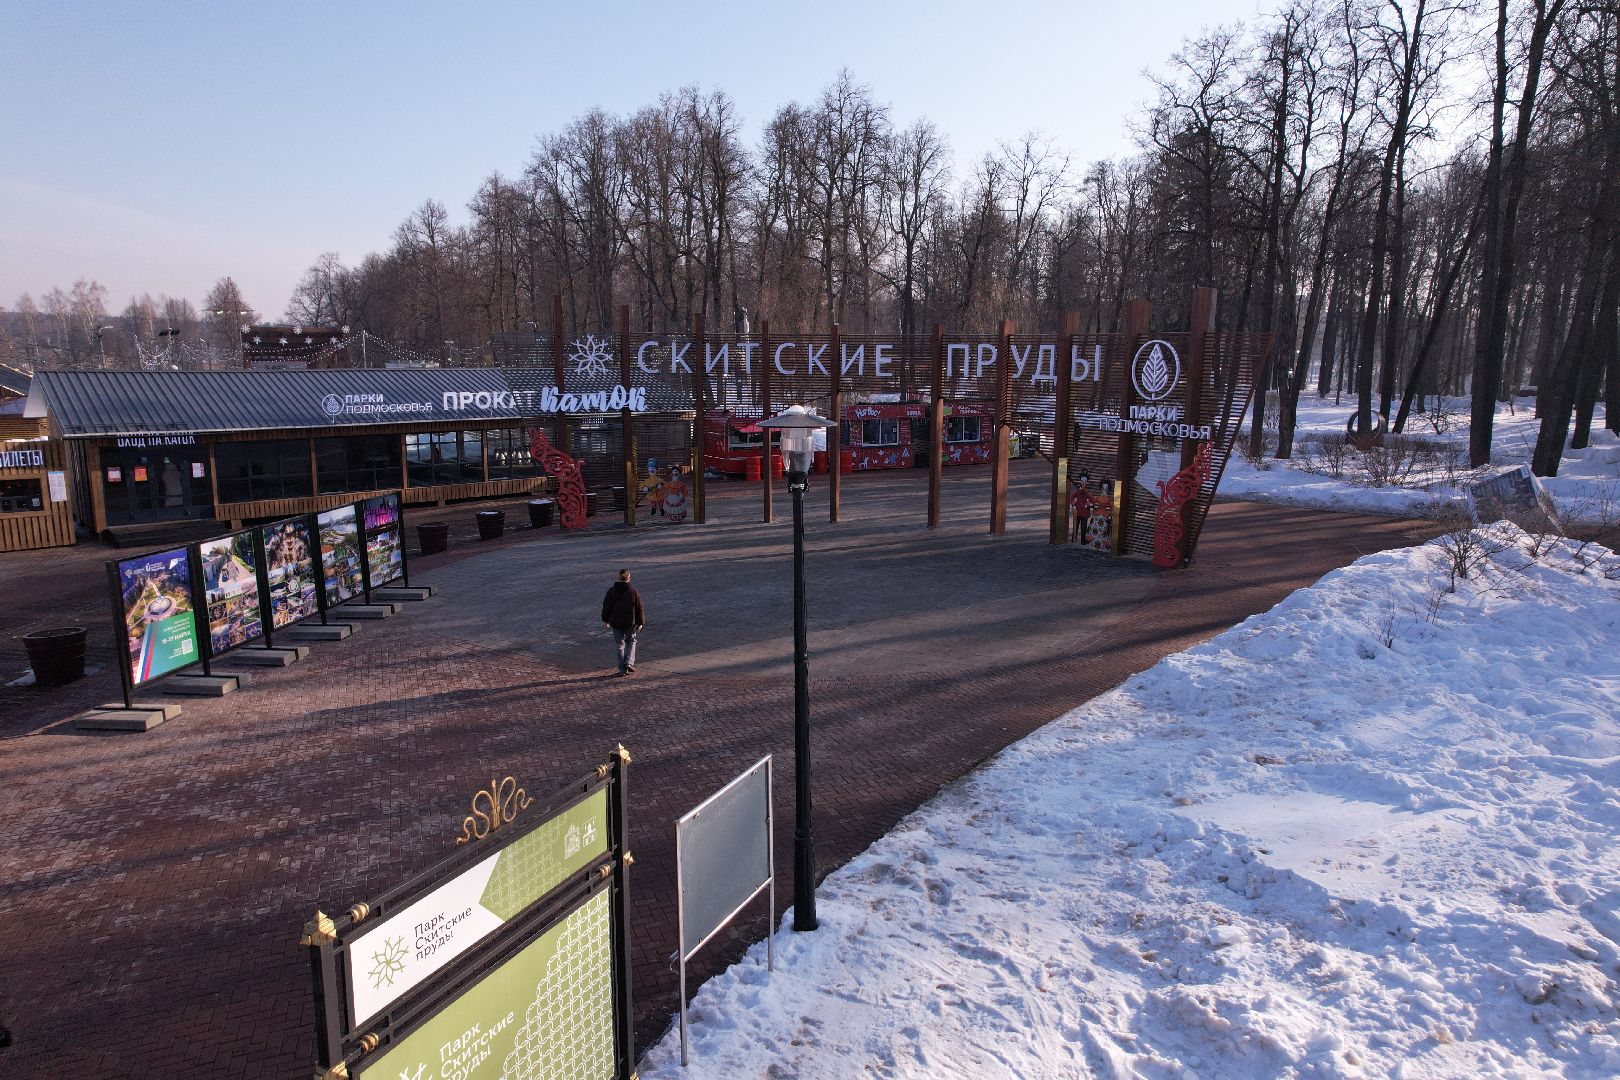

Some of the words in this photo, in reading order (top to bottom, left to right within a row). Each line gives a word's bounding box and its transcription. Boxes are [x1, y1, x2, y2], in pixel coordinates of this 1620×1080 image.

[637, 340, 893, 377] СКИТСКИЕ
[947, 343, 1102, 386] ПРУДЫ
[345, 394, 384, 403] ПАРКИ
[346, 402, 433, 414] ПОДМОСКОВЬЯ
[1129, 405, 1178, 421] ПАРКИ
[1099, 417, 1211, 440] ПОДМОСКОВЬЯ
[414, 911, 445, 938] Парк
[415, 907, 472, 950] Скитские
[416, 930, 454, 961] пруды
[439, 1022, 480, 1062] Парк
[441, 1011, 514, 1078] Скитские
[447, 1044, 492, 1080] руды
